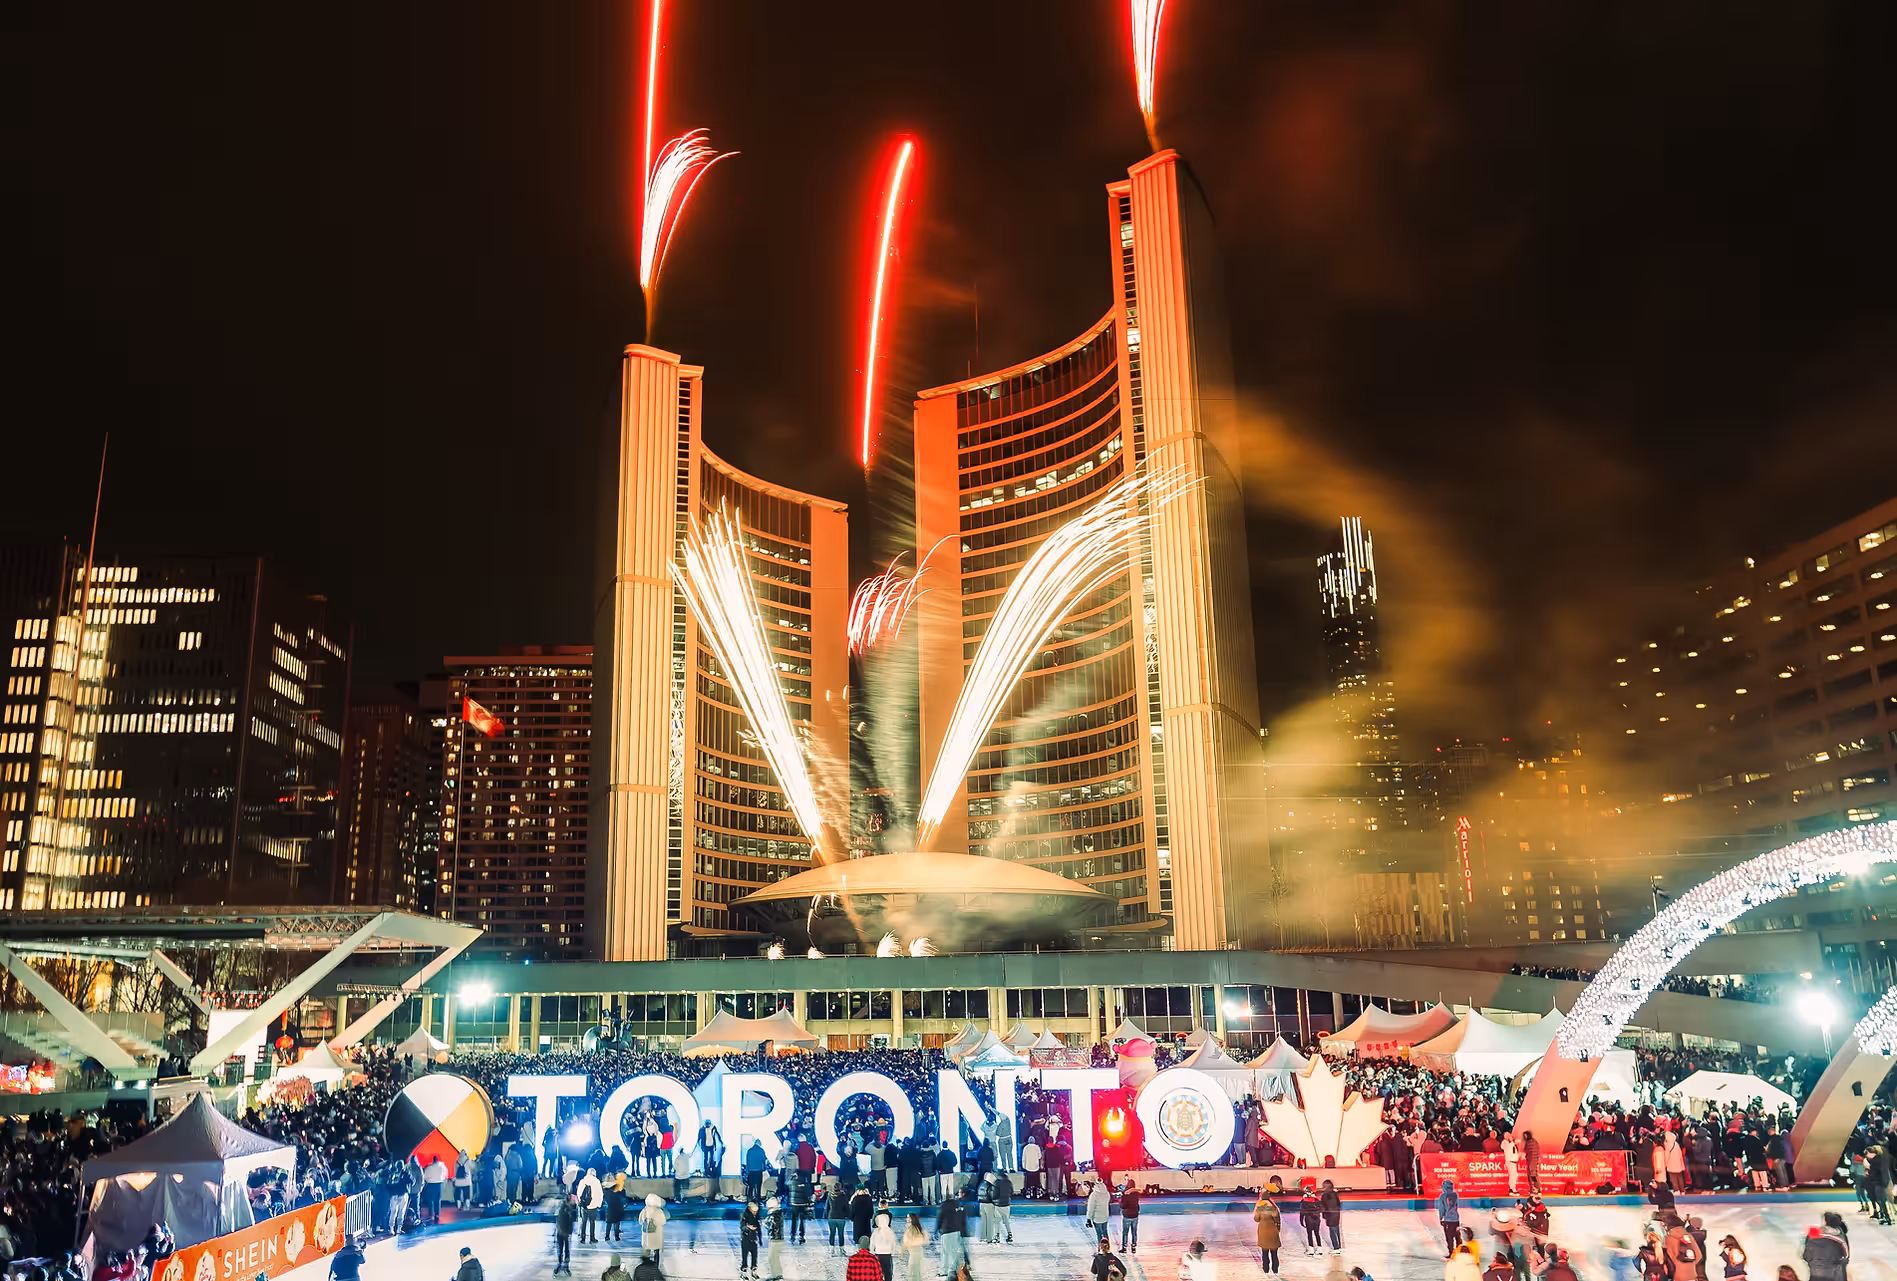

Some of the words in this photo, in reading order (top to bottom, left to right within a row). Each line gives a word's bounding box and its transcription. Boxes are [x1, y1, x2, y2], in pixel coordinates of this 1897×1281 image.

[507, 1068, 1235, 1177] TORONTO
[1468, 1161, 1502, 1171] SPARK
[1540, 1163, 1557, 1171] New
[1558, 1163, 1578, 1171] Year!
[223, 1234, 278, 1278] SHEIN
